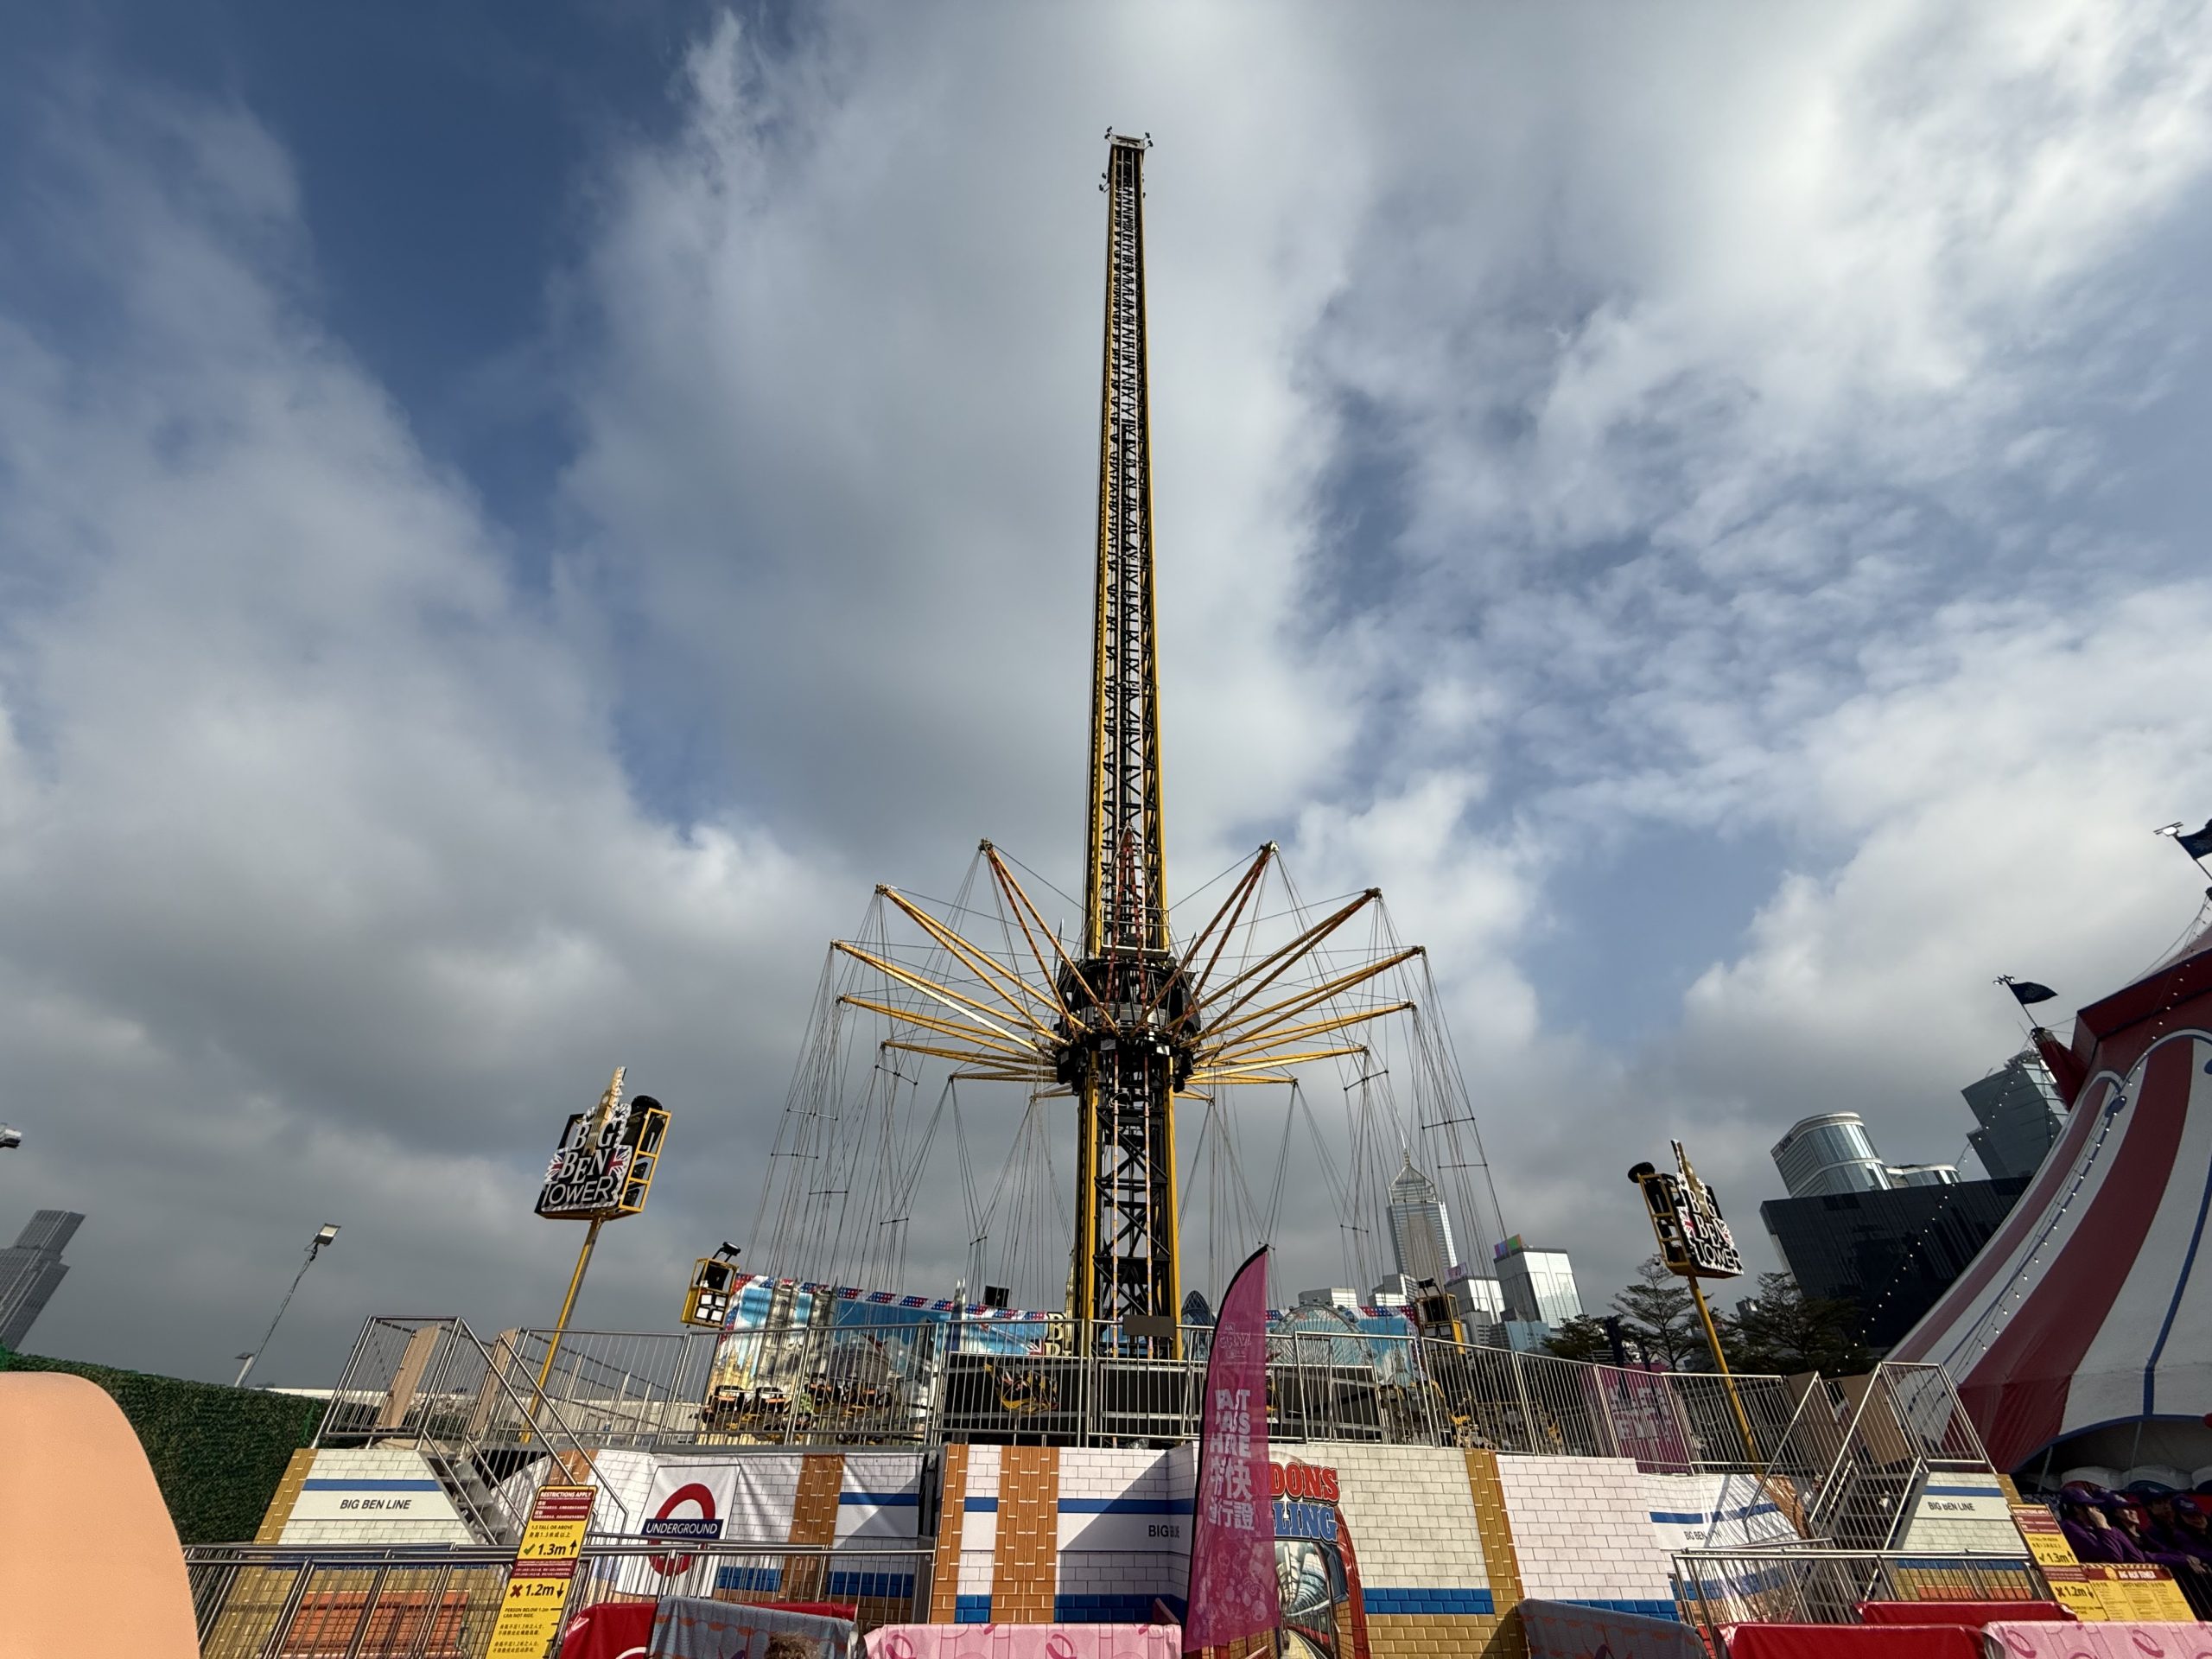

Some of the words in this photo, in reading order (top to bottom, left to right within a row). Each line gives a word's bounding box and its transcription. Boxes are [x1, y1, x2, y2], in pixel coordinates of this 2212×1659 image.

[558, 1148, 610, 1185] BEN
[542, 1176, 613, 1205] TOWER
[1694, 1214, 1726, 1248] BEN
[1695, 1238, 1743, 1270] TOWER
[1269, 1461, 1340, 1503] DONS
[340, 1499, 359, 1510] BIG
[361, 1499, 385, 1510] BEN
[385, 1499, 411, 1510] LINE
[1927, 1502, 1942, 1510] BIG
[1942, 1502, 1958, 1511] BEN
[1957, 1503, 1975, 1511] LINE
[1273, 1501, 1338, 1542] LING
[645, 1522, 718, 1535] UNDERGROUND
[1147, 1525, 1169, 1537] BIG
[537, 1543, 567, 1556] 1.3m
[2046, 1553, 2069, 1563] 1.3m
[525, 1584, 555, 1596] 1.2m
[2064, 1586, 2088, 1598] 1.2m
